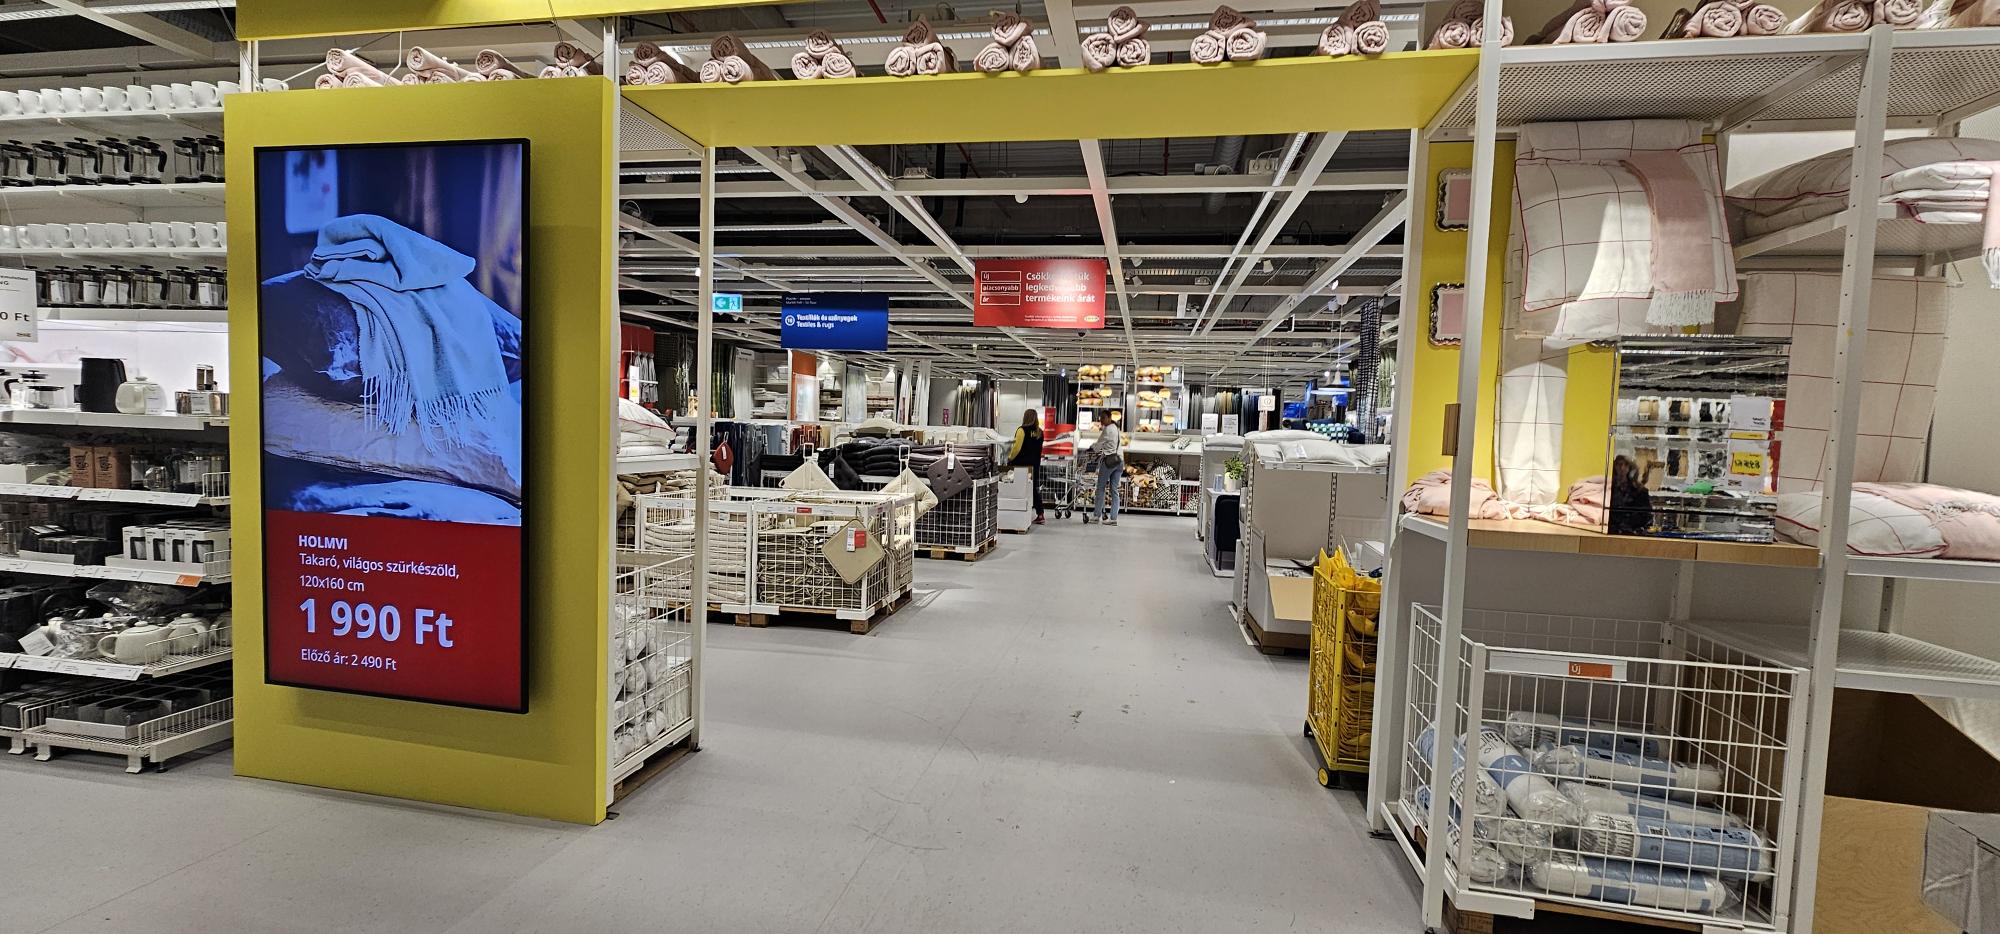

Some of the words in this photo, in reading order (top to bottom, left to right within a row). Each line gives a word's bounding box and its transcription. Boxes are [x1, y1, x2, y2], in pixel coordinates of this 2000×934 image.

[1025, 295, 1074, 303] termékeink
[15, 313, 30, 321] Ft
[298, 535, 347, 550] HOLMVI
[299, 553, 340, 569] Takaró,
[343, 557, 383, 574] világos
[386, 562, 460, 579] szürkészöld,
[299, 575, 345, 590] 120x160
[347, 580, 365, 592] cm
[300, 598, 316, 633] 1
[331, 600, 401, 642] 990
[415, 608, 454, 648] Ft
[301, 649, 331, 663] Előző
[333, 651, 349, 665] ár:
[351, 654, 358, 666] 2
[361, 655, 382, 669] 490
[385, 657, 397, 671] Ft
